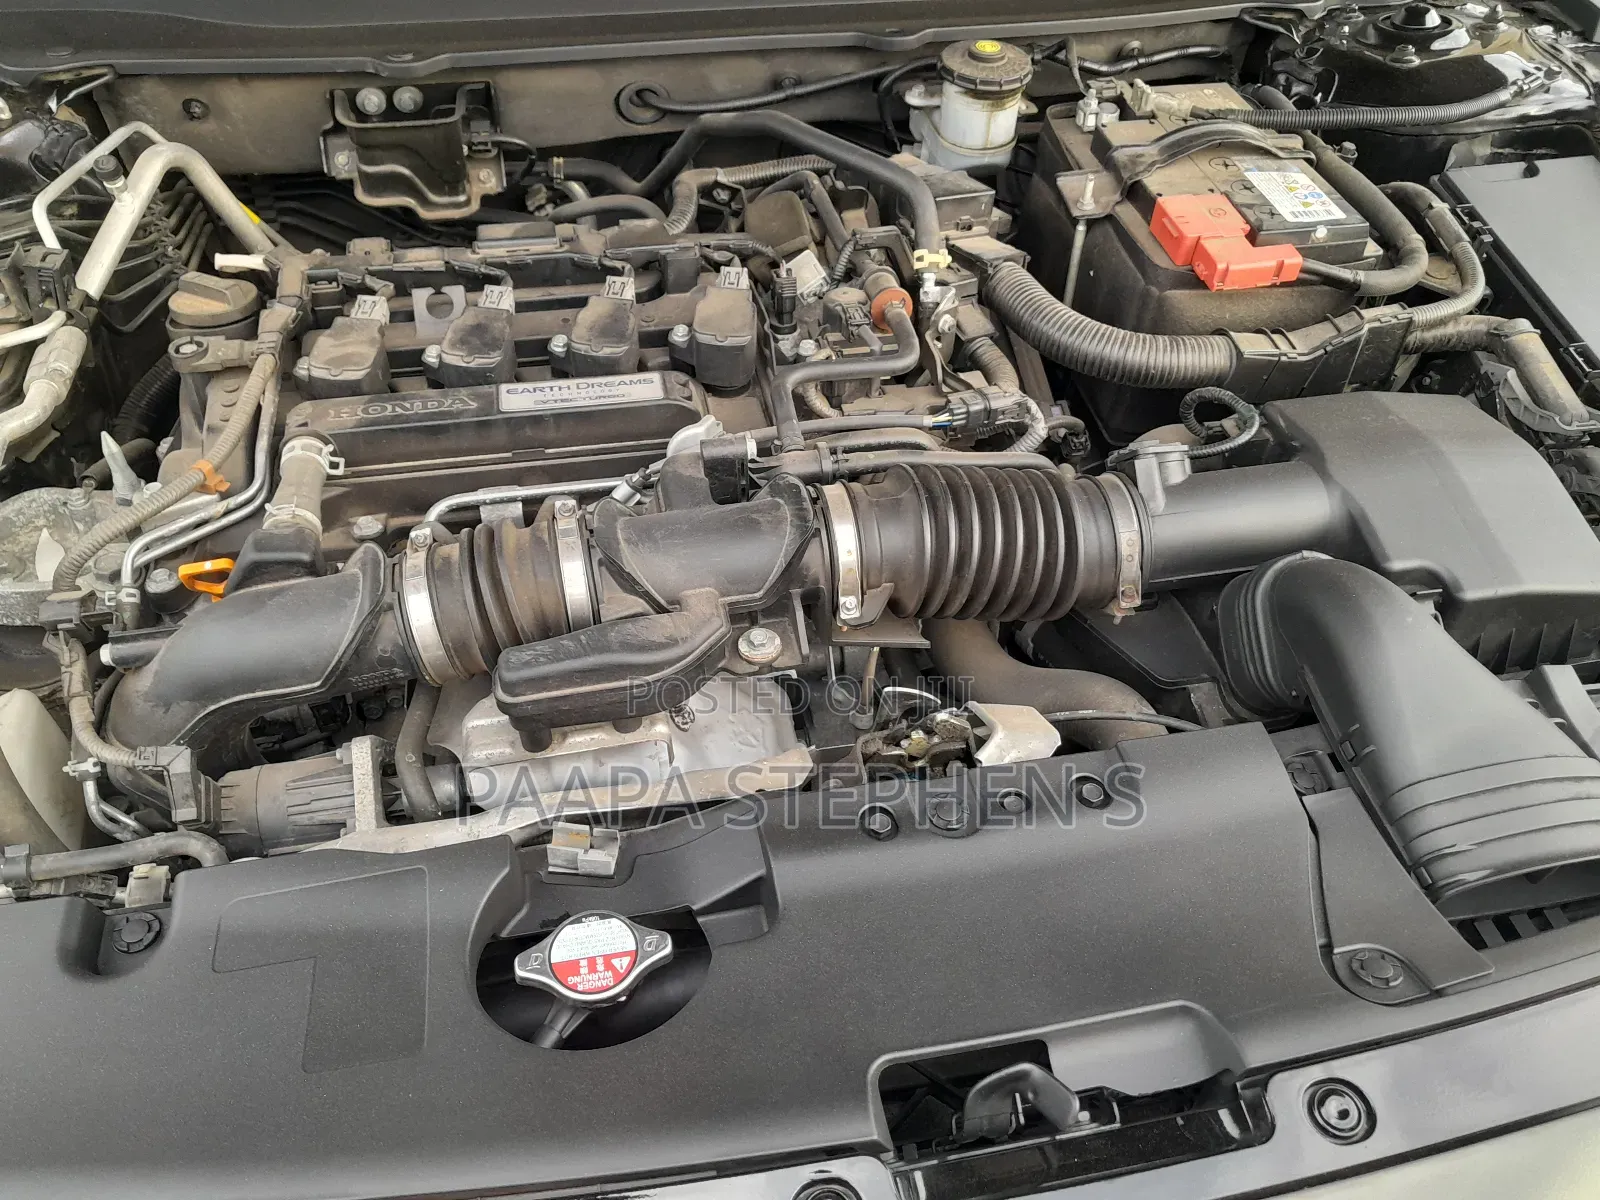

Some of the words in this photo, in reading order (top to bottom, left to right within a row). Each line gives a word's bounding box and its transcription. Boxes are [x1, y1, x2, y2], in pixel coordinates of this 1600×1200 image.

[506, 384, 571, 395] EARTH
[576, 377, 655, 390] DREAMS
[327, 395, 479, 421] HONDA
[567, 970, 613, 984] WARNUNG
[577, 977, 615, 991] DANGER
